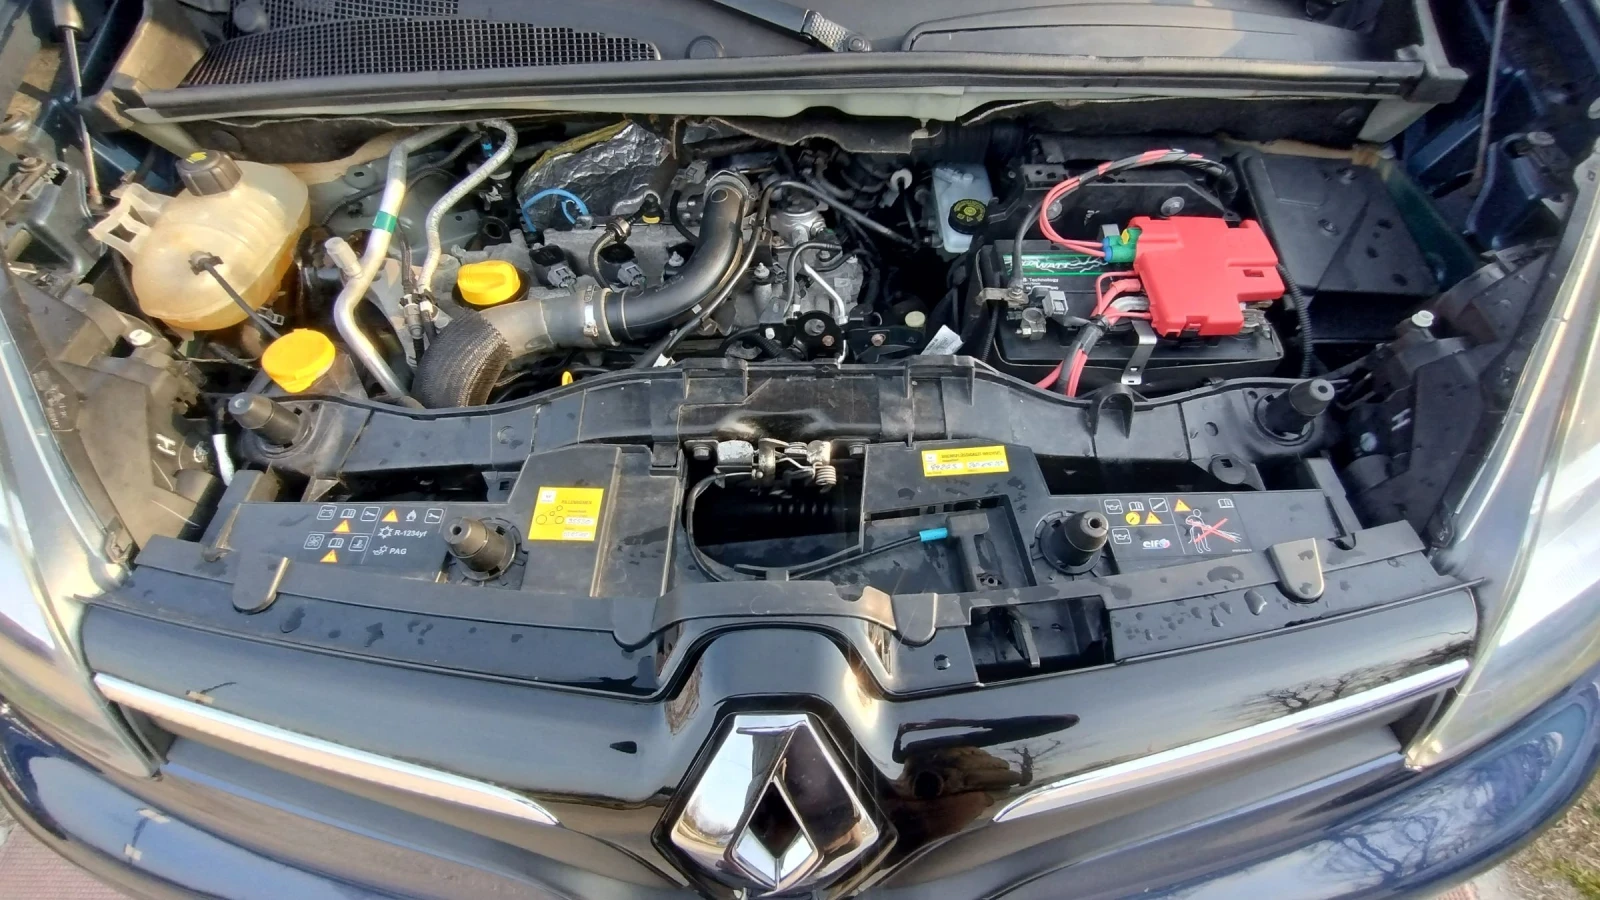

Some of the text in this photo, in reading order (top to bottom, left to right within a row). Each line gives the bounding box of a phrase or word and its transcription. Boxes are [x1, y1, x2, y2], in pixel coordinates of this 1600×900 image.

[394, 529, 428, 538] R-1234yf
[1143, 540, 1161, 548] elf
[389, 547, 407, 555] PAG
